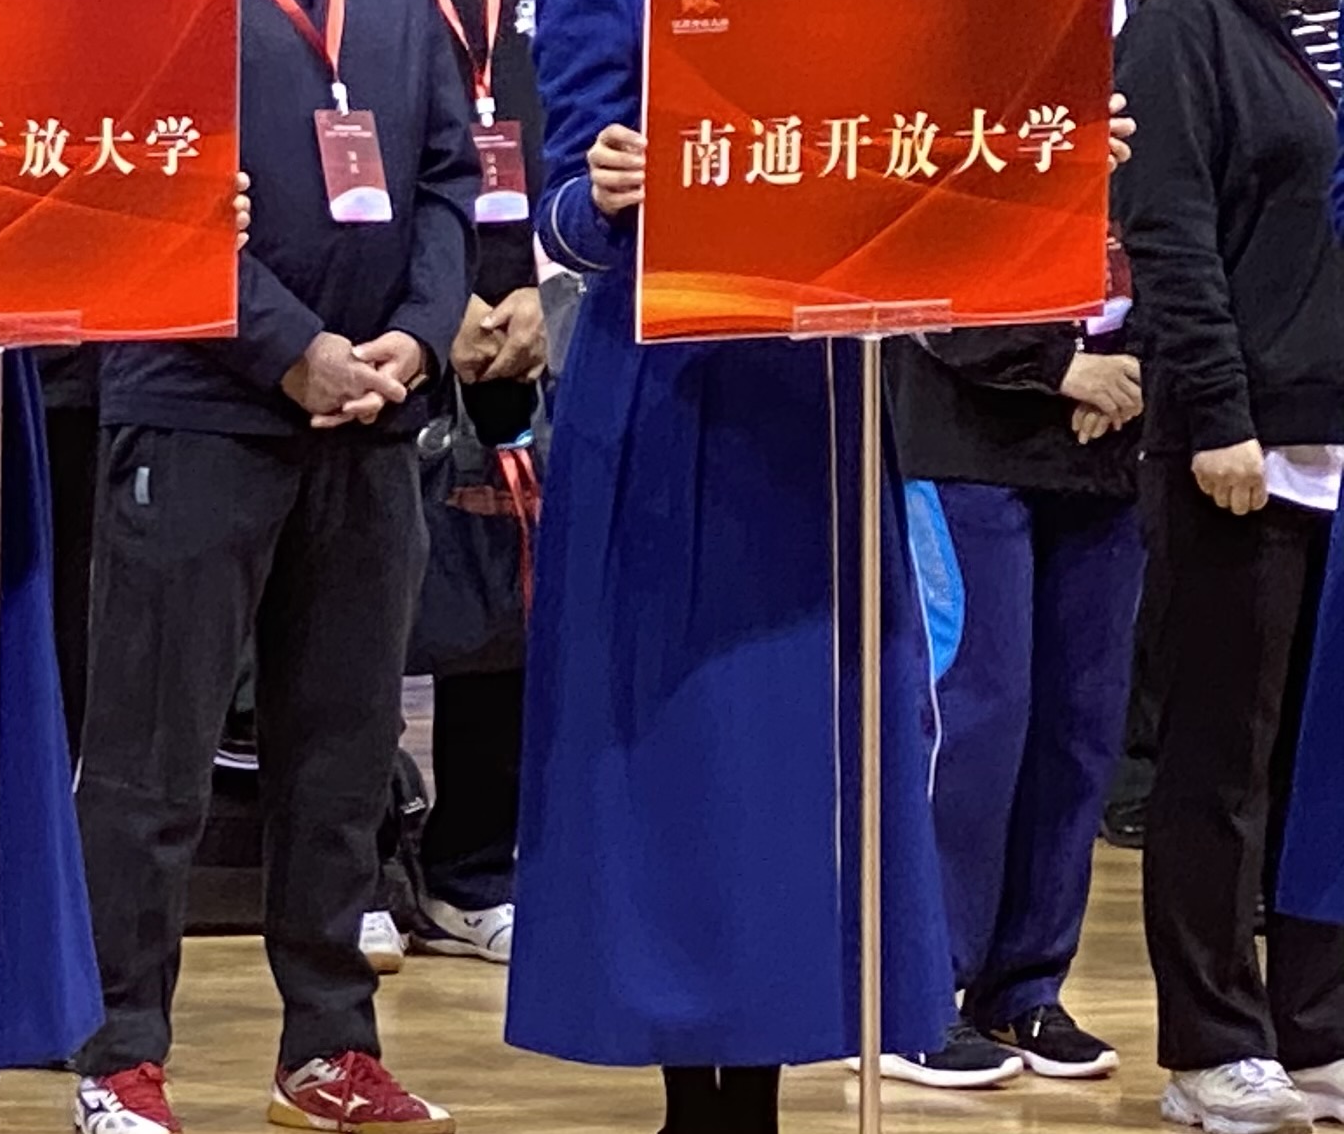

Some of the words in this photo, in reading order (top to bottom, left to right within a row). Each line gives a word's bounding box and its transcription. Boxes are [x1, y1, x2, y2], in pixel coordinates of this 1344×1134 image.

[681, 104, 1077, 189] 南通开放大学
